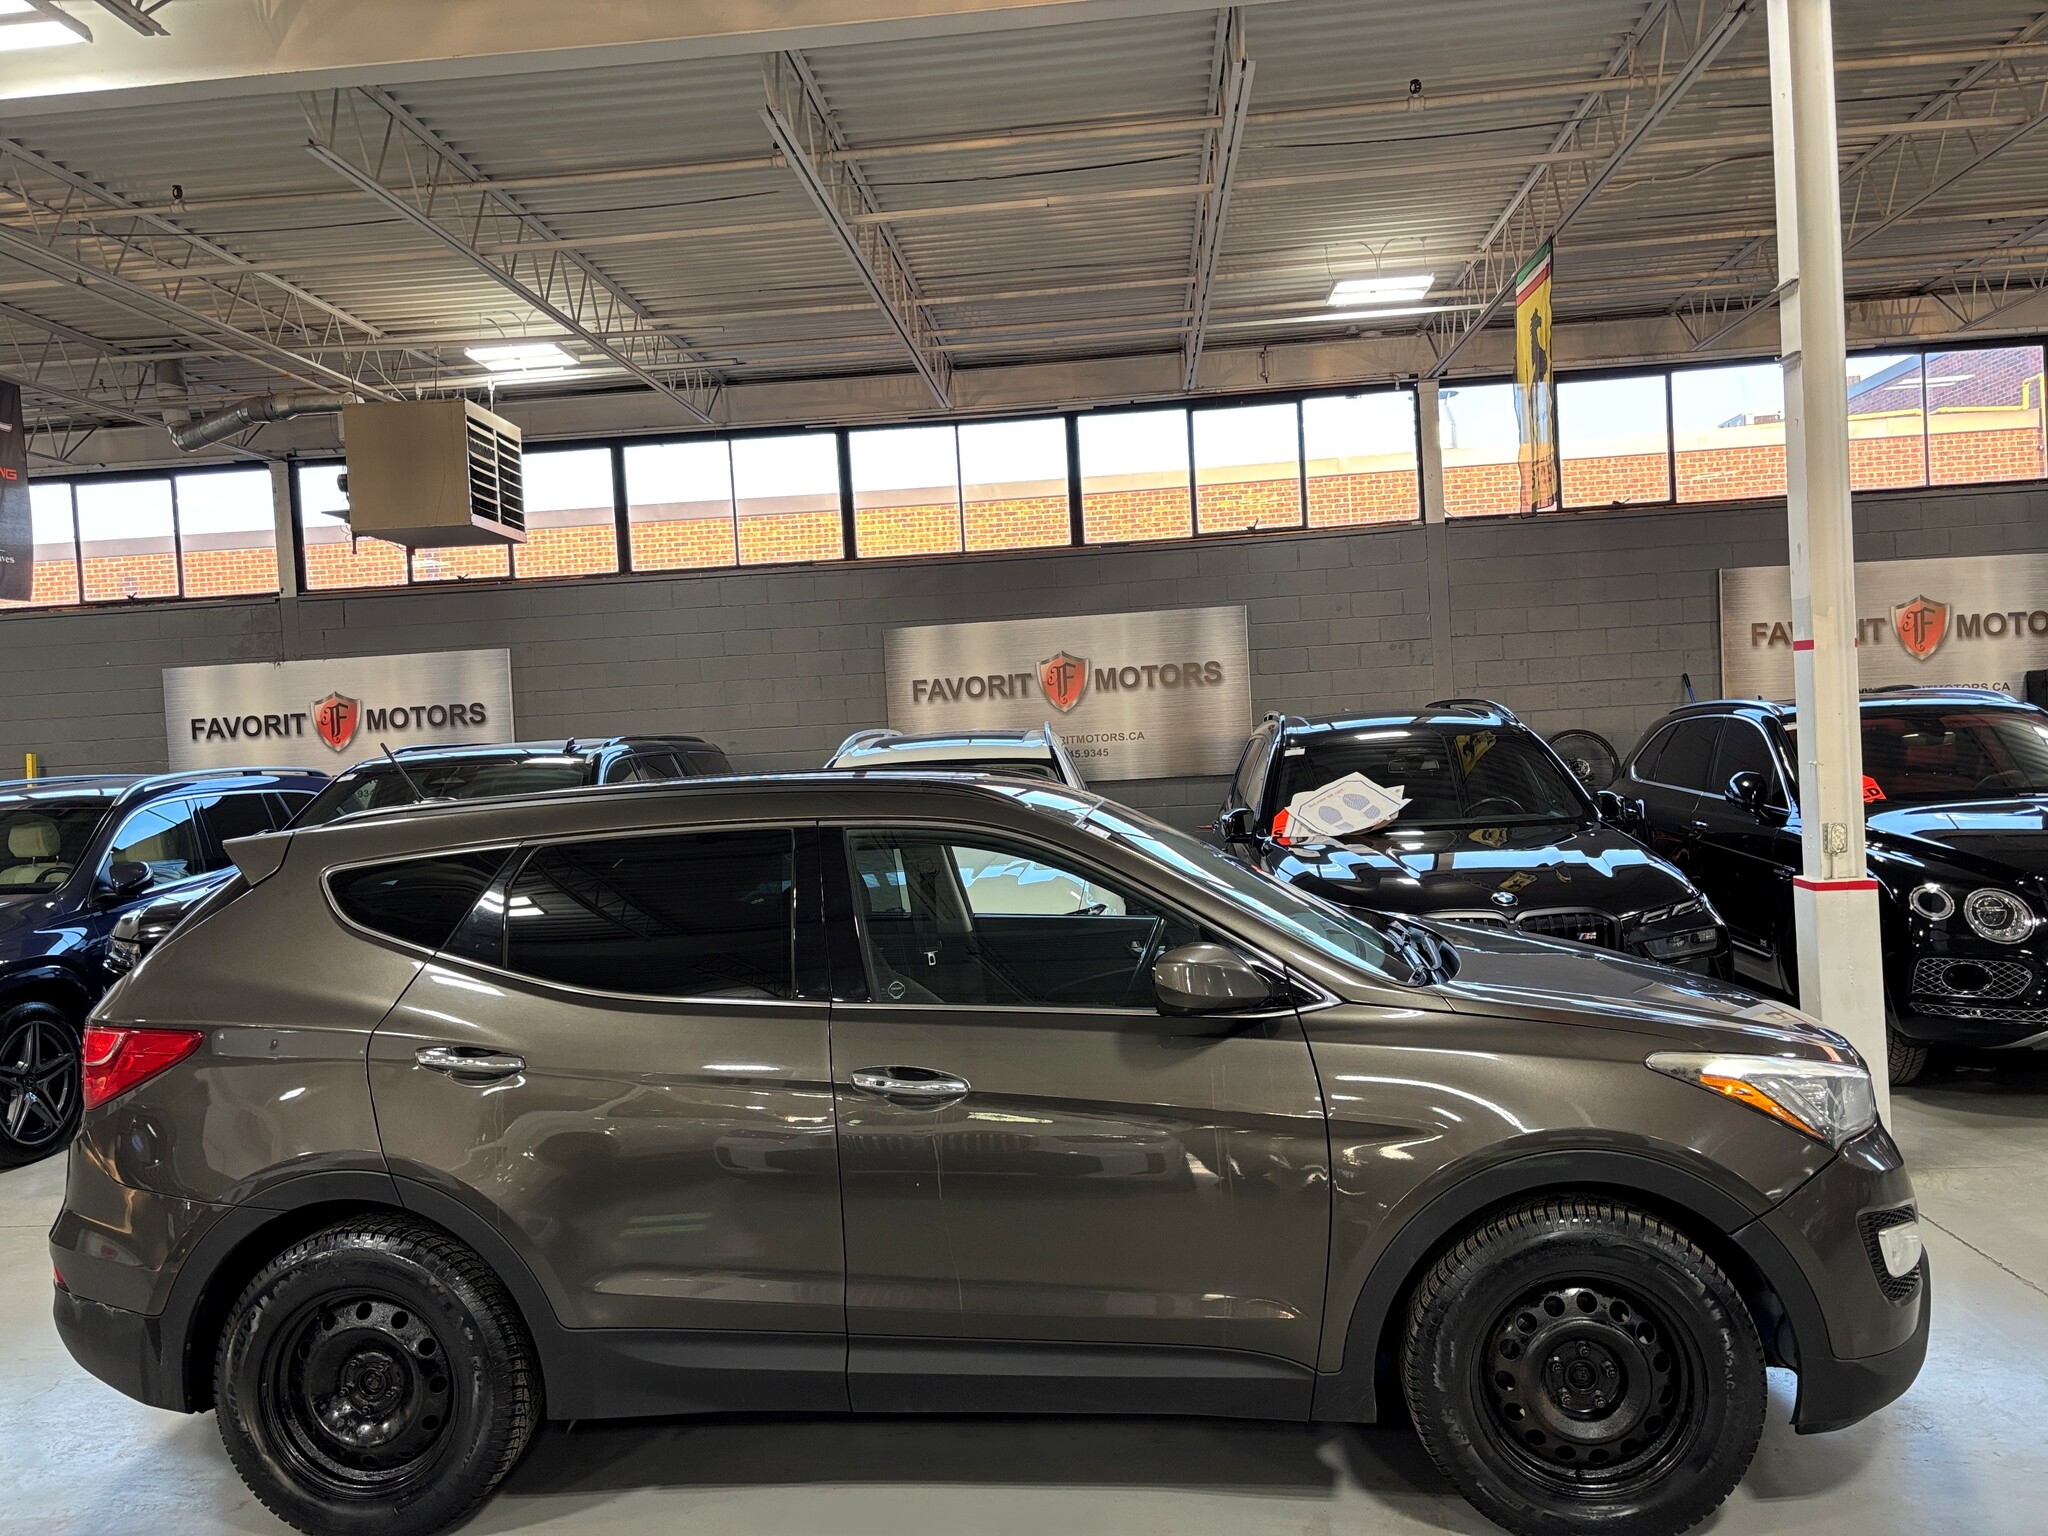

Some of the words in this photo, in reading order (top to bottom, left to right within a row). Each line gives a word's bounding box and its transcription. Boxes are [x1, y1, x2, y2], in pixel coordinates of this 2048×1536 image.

[912, 672, 1032, 702] FAVORIT
[1095, 660, 1222, 691] MOTORS
[191, 712, 306, 740] FAVORIT
[366, 702, 487, 731] MOTORS
